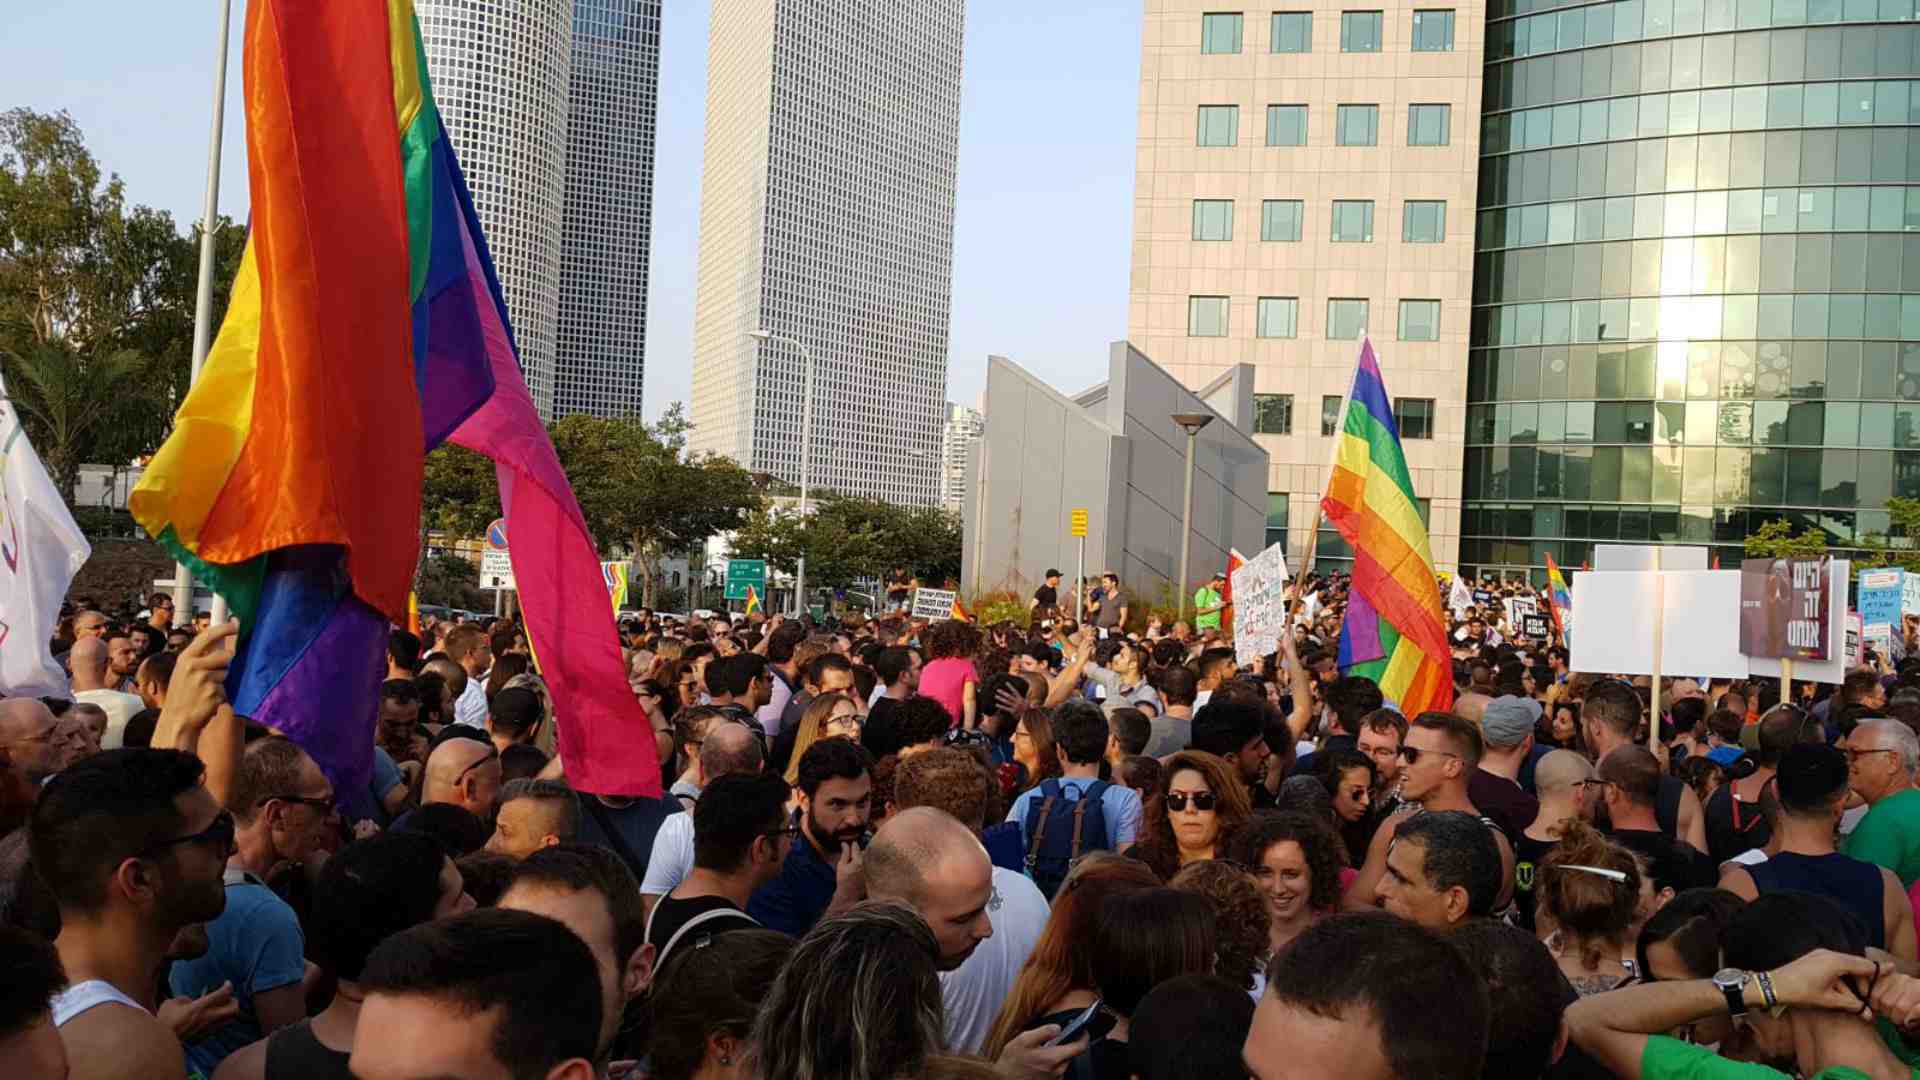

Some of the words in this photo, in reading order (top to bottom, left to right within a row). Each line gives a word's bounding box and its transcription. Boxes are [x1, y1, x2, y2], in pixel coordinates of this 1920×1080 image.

[1793, 561, 1821, 589] היום
[1804, 591, 1820, 618] זה
[1787, 620, 1820, 648] אנחנו
